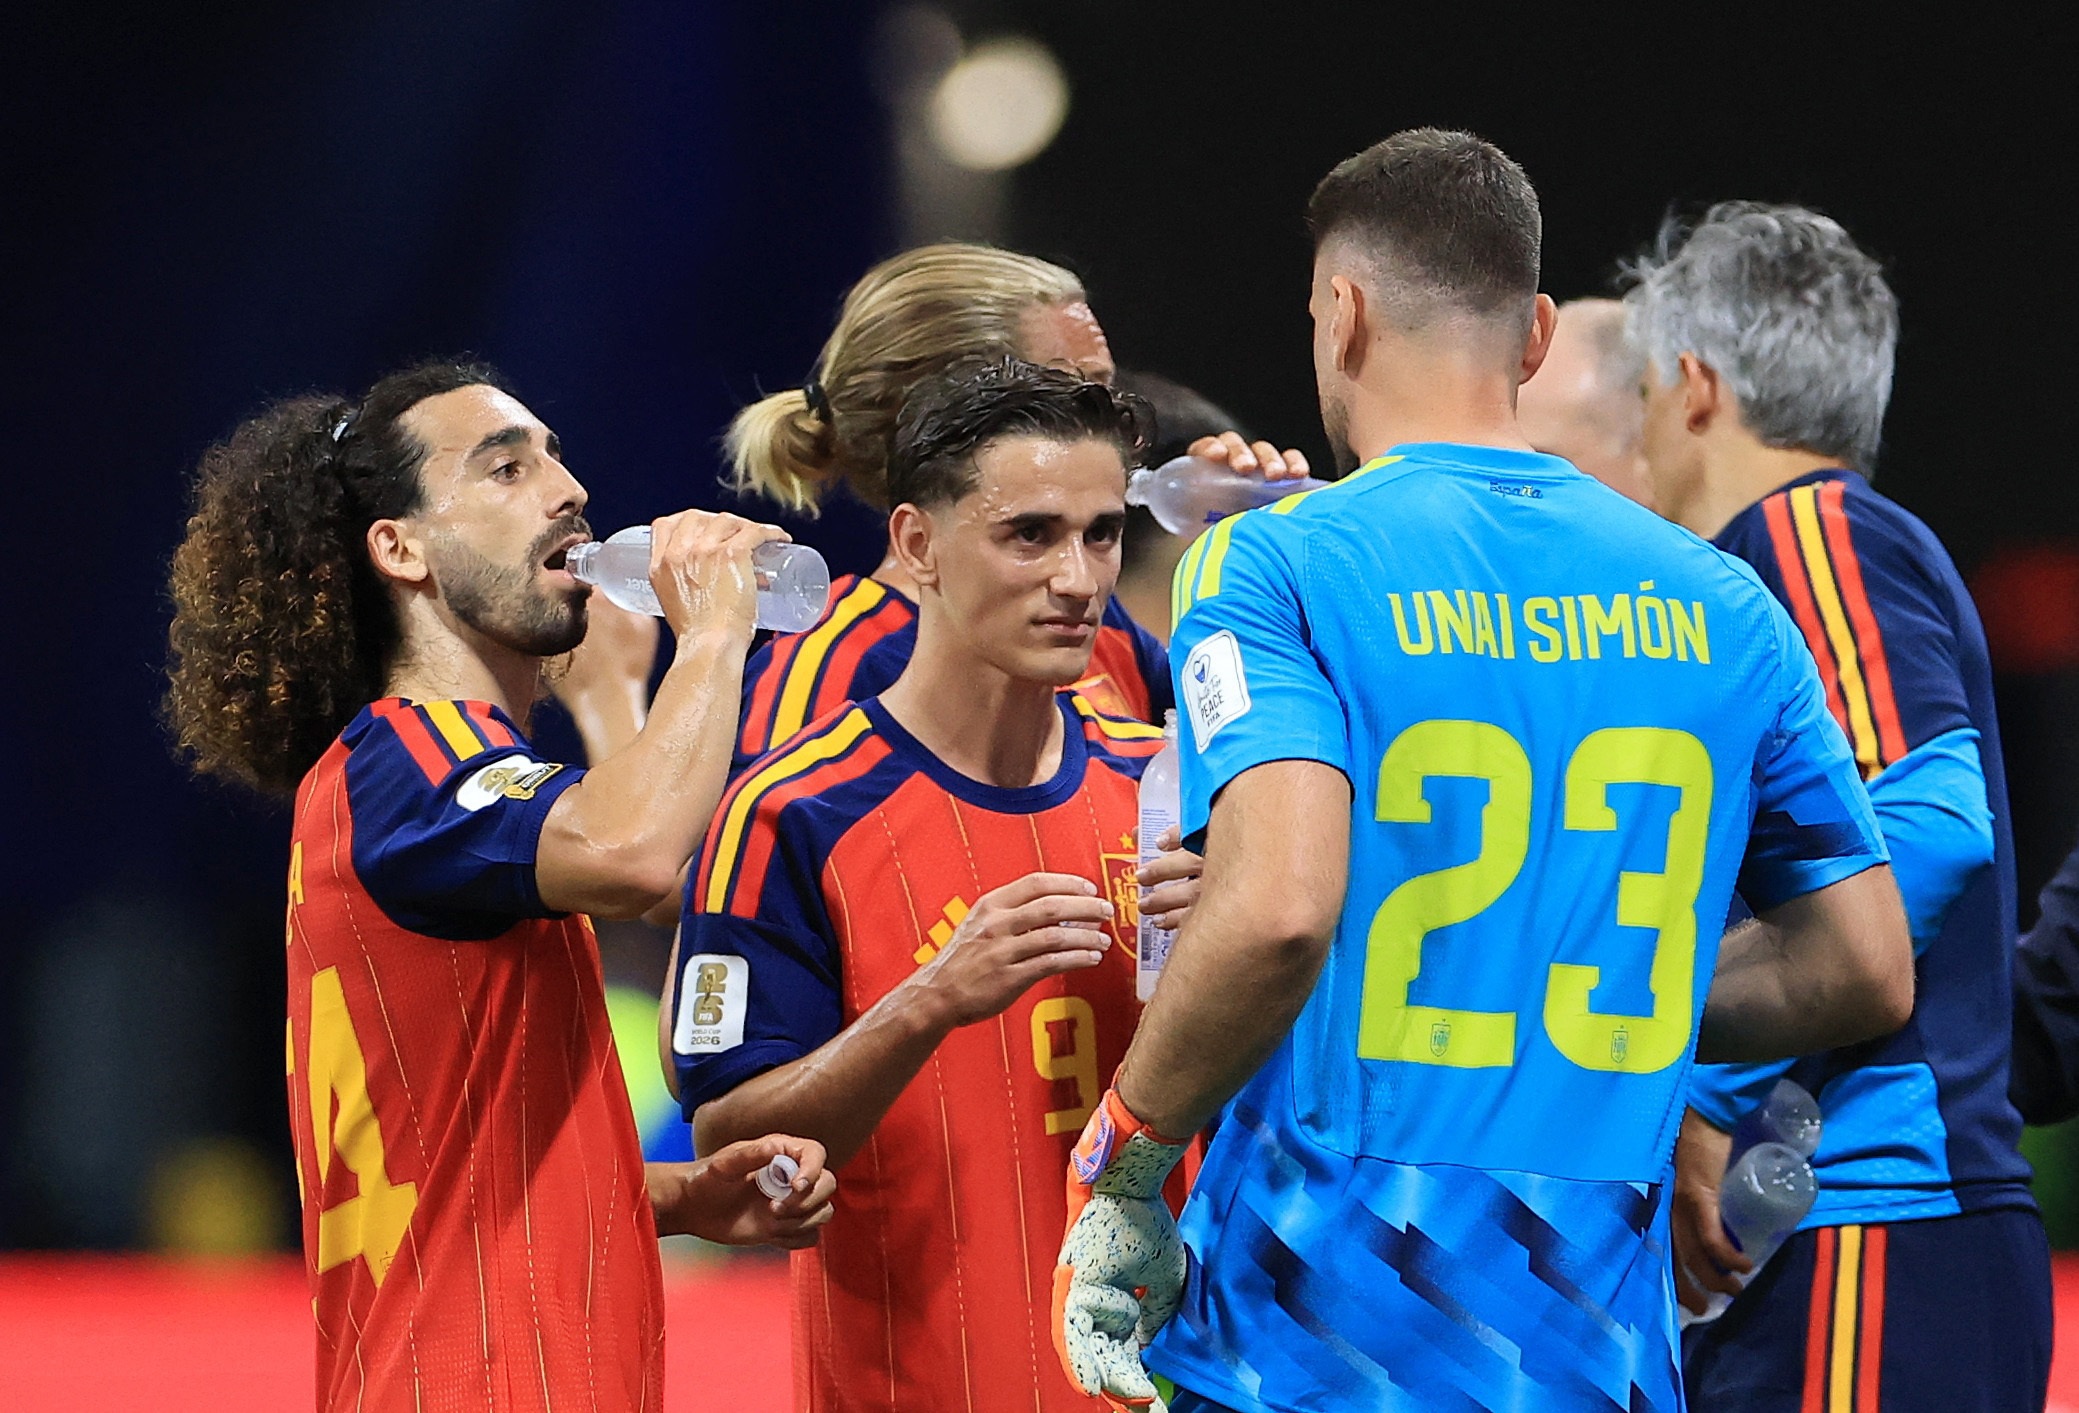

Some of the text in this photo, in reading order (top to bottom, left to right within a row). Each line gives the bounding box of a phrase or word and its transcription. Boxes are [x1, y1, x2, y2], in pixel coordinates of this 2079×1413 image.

[1489, 481, 1544, 499] España
[1387, 579, 1711, 665] UNAI SIMÓN
[1200, 690, 1225, 720] PEACE
[1356, 719, 1714, 1074] 23
[690, 1035, 721, 1046] 2026
[1031, 996, 1100, 1136] 9
[286, 965, 417, 1288] 4
